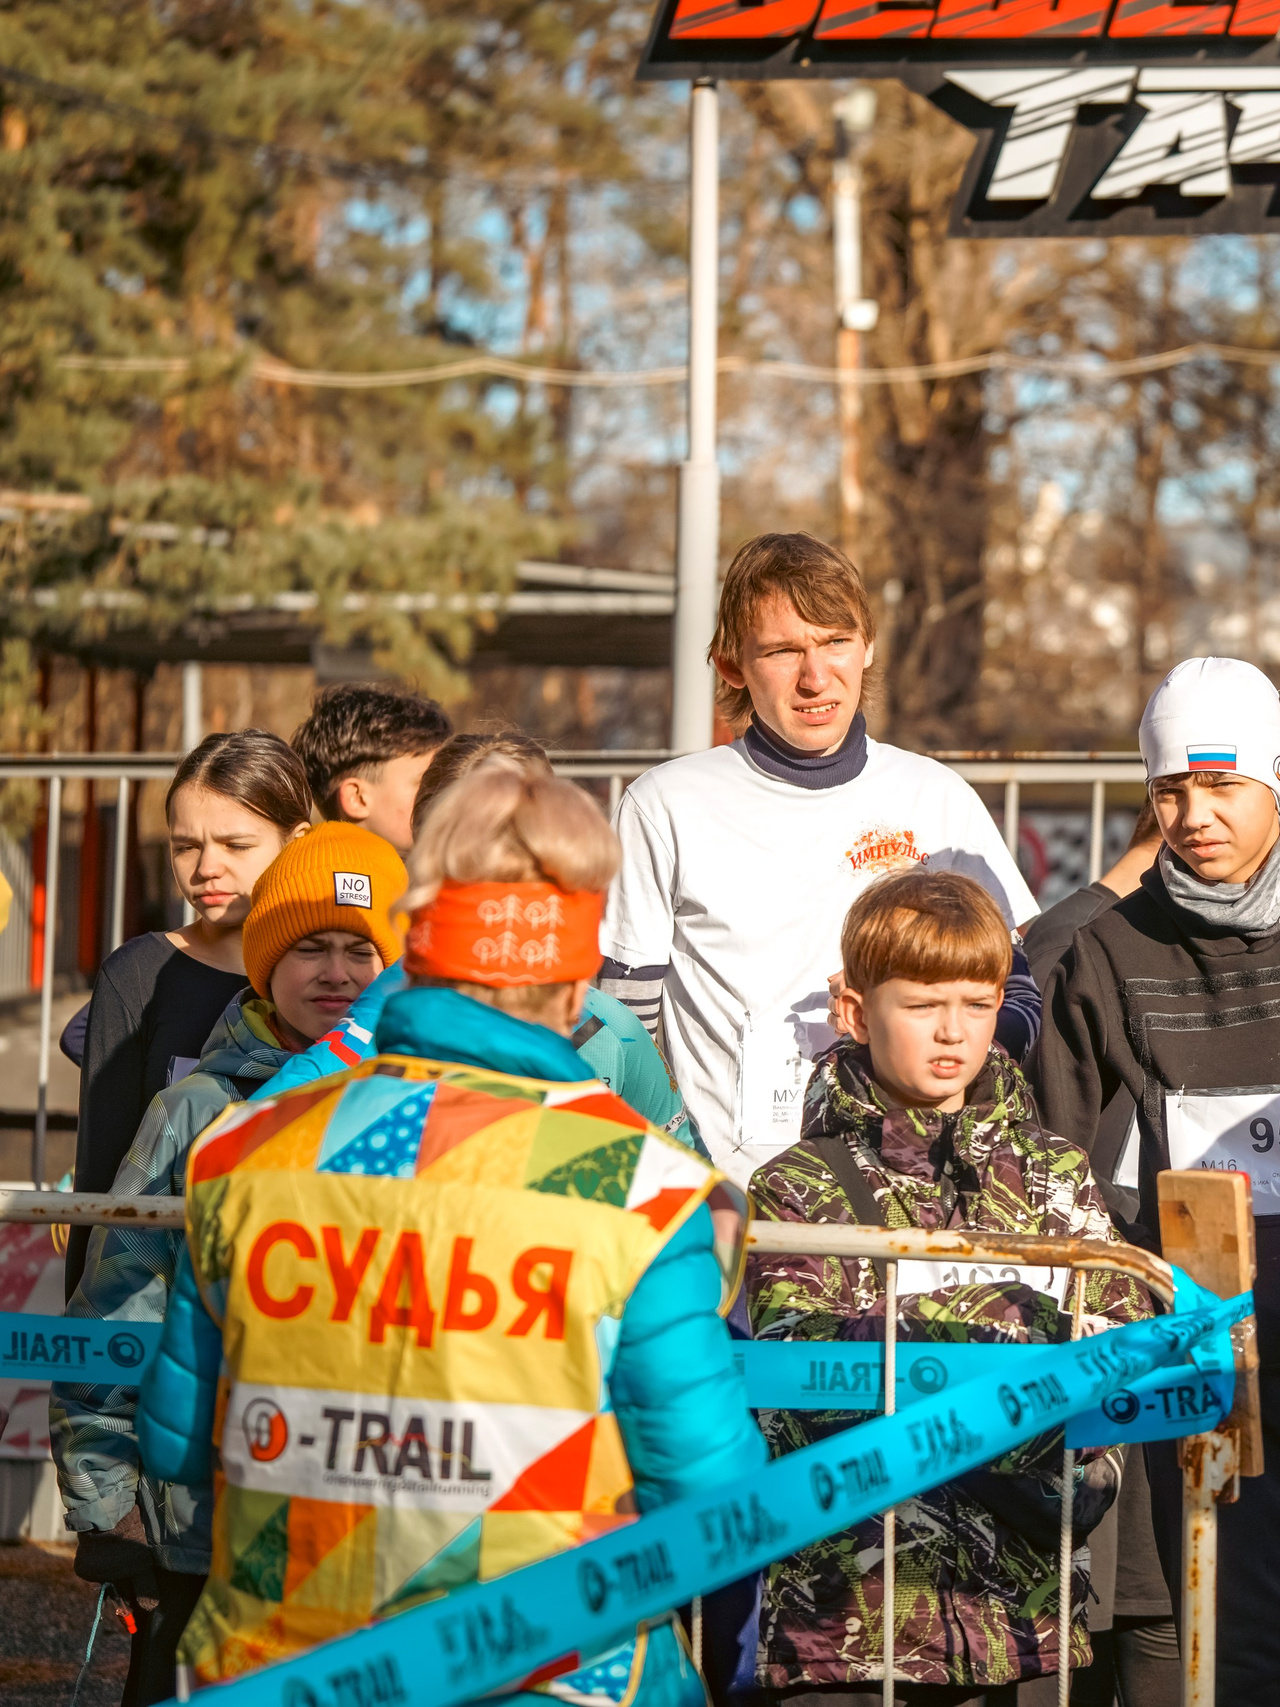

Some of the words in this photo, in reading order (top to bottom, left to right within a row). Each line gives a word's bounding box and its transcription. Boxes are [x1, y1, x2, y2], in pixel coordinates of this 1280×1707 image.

[850, 841, 930, 870] ИМПУЛЬС
[342, 878, 364, 891] NO
[340, 892, 369, 902] STRESS!
[773, 1089, 804, 1103] МУ
[247, 1219, 573, 1348] СУДЬЯ
